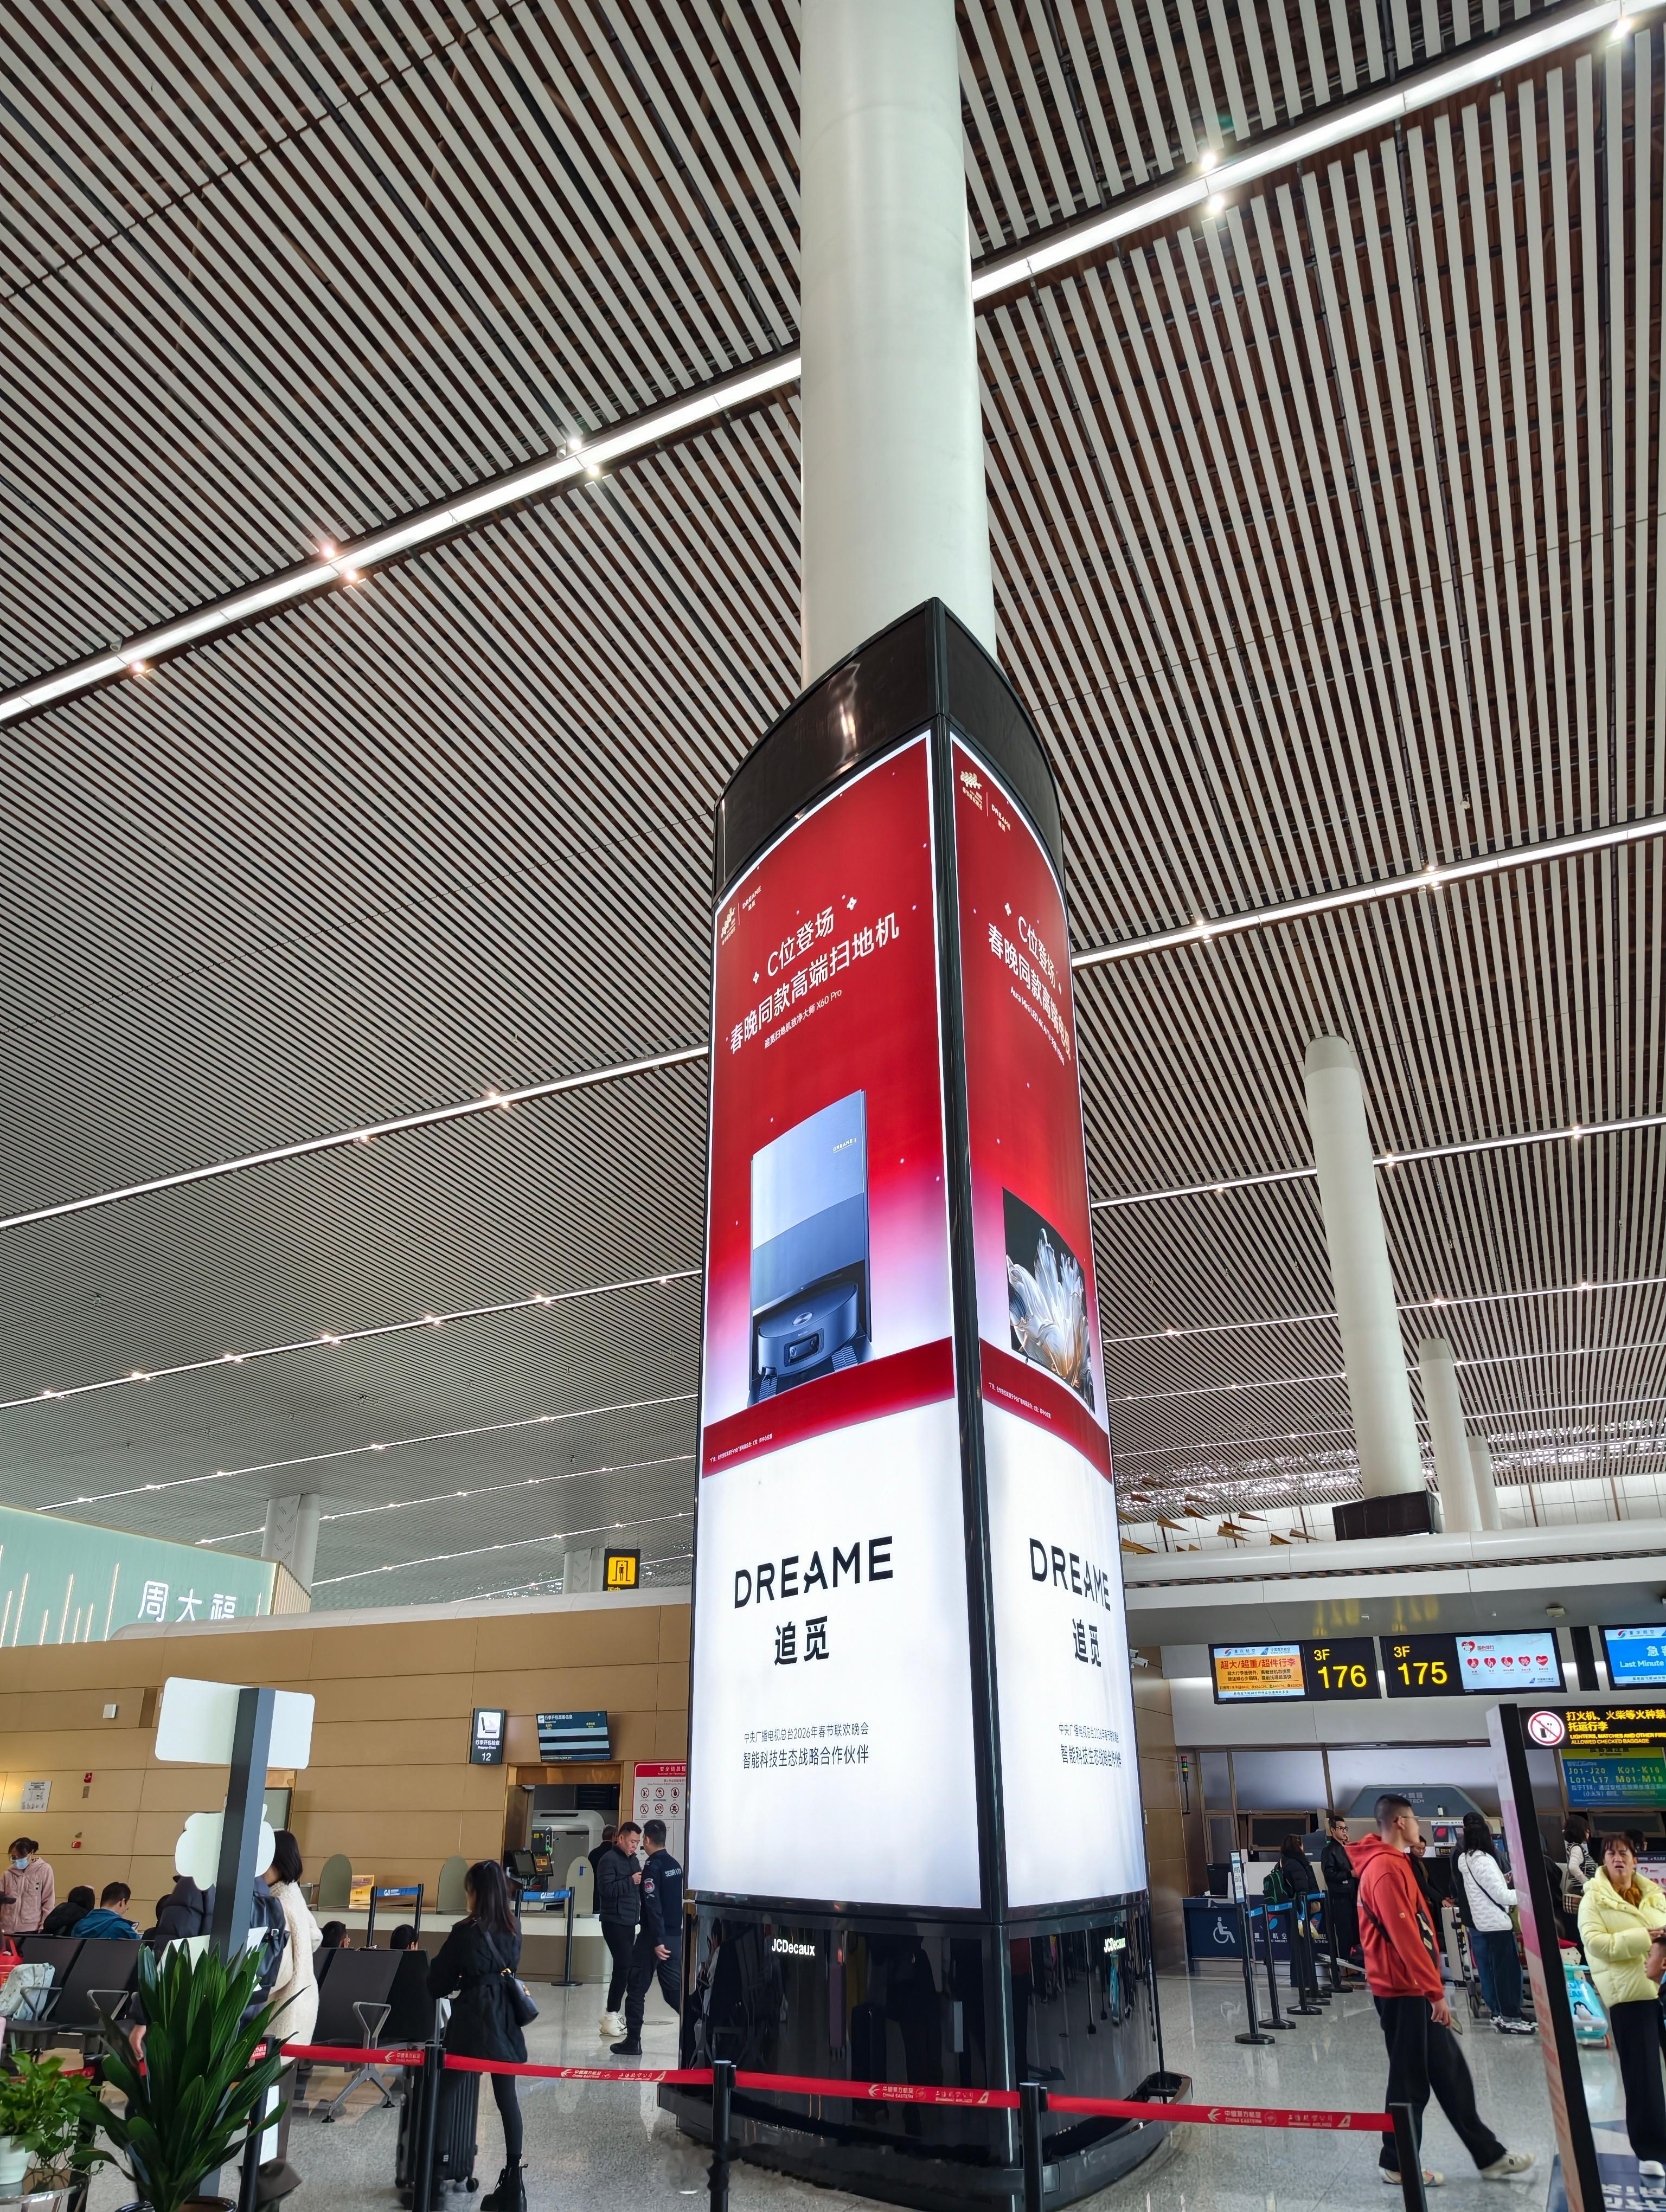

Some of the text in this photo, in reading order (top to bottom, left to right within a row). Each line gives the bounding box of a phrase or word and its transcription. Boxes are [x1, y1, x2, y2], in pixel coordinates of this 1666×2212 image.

[991, 804, 1010, 831] DREAME
[742, 885, 761, 909] DREAME
[767, 906, 834, 976] C位登场
[1018, 916, 1055, 988] C位登场
[731, 912, 899, 1054] 春晚同款高端扫地机
[988, 922, 1071, 1060] 春晚同款高端电视
[1011, 986, 1021, 1002] Aura
[765, 989, 842, 1049] 追觅扫地机致净大师 X60 Pro
[833, 1139, 853, 1152] DREAME
[735, 1536, 893, 1609] DREAME
[1029, 1538, 1111, 1611] DREAME
[137, 1580, 237, 1622] 周大福
[774, 1616, 830, 1666] 追觅
[1072, 1618, 1101, 1667] 追觅
[1394, 1646, 1410, 1658] 3F
[1220, 1658, 1296, 1669] 超大/超重/超件行李
[1314, 1649, 1330, 1661] 3F
[1318, 1665, 1367, 1688] 176
[1398, 1662, 1447, 1685] 175
[744, 1722, 869, 1744] 中央广播电视总台2026年春节联欢晚会
[1568, 1721, 1609, 1731] 托运行李
[482, 1752, 491, 1761] 12
[744, 1744, 869, 1769] 智能科技生态战略合作伙伴
[1061, 1744, 1121, 1768] 智能科技生态战略合作伙伴
[771, 1938, 815, 1956] JCDecaux
[1104, 1937, 1126, 1953] JCDecaux
